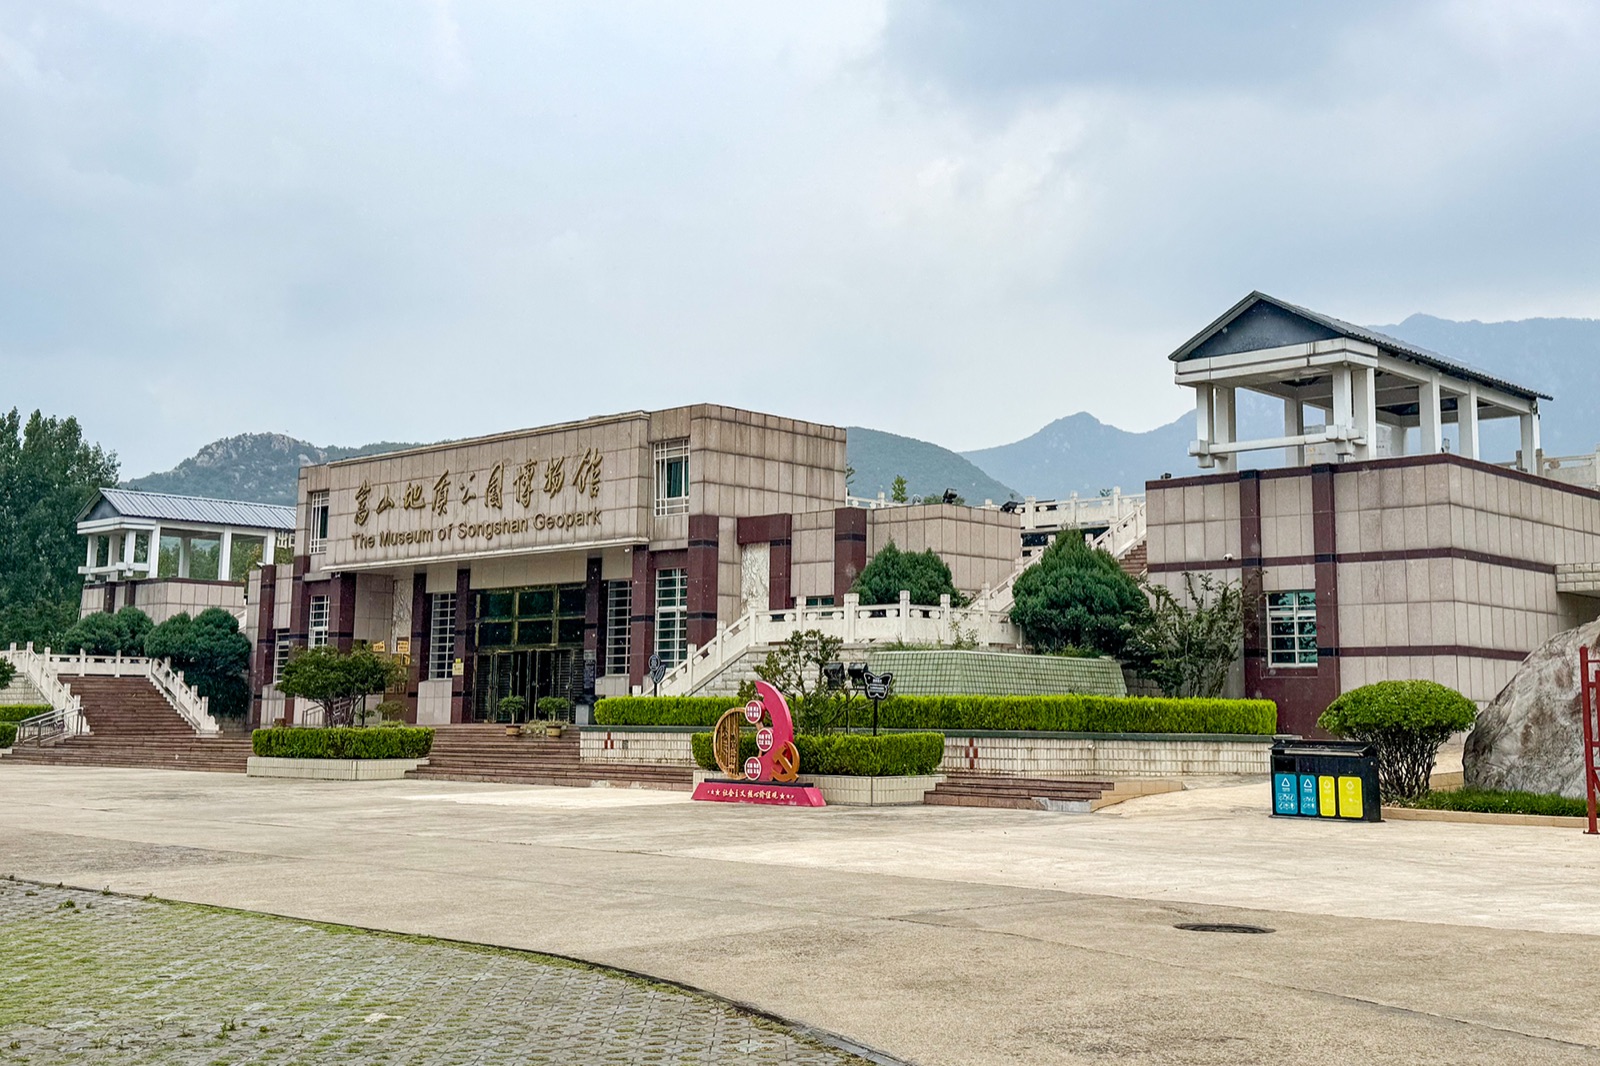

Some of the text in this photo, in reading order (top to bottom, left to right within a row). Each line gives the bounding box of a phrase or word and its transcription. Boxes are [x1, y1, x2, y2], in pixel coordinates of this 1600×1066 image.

[352, 507, 602, 550] The Museum of Songshan Geopark
